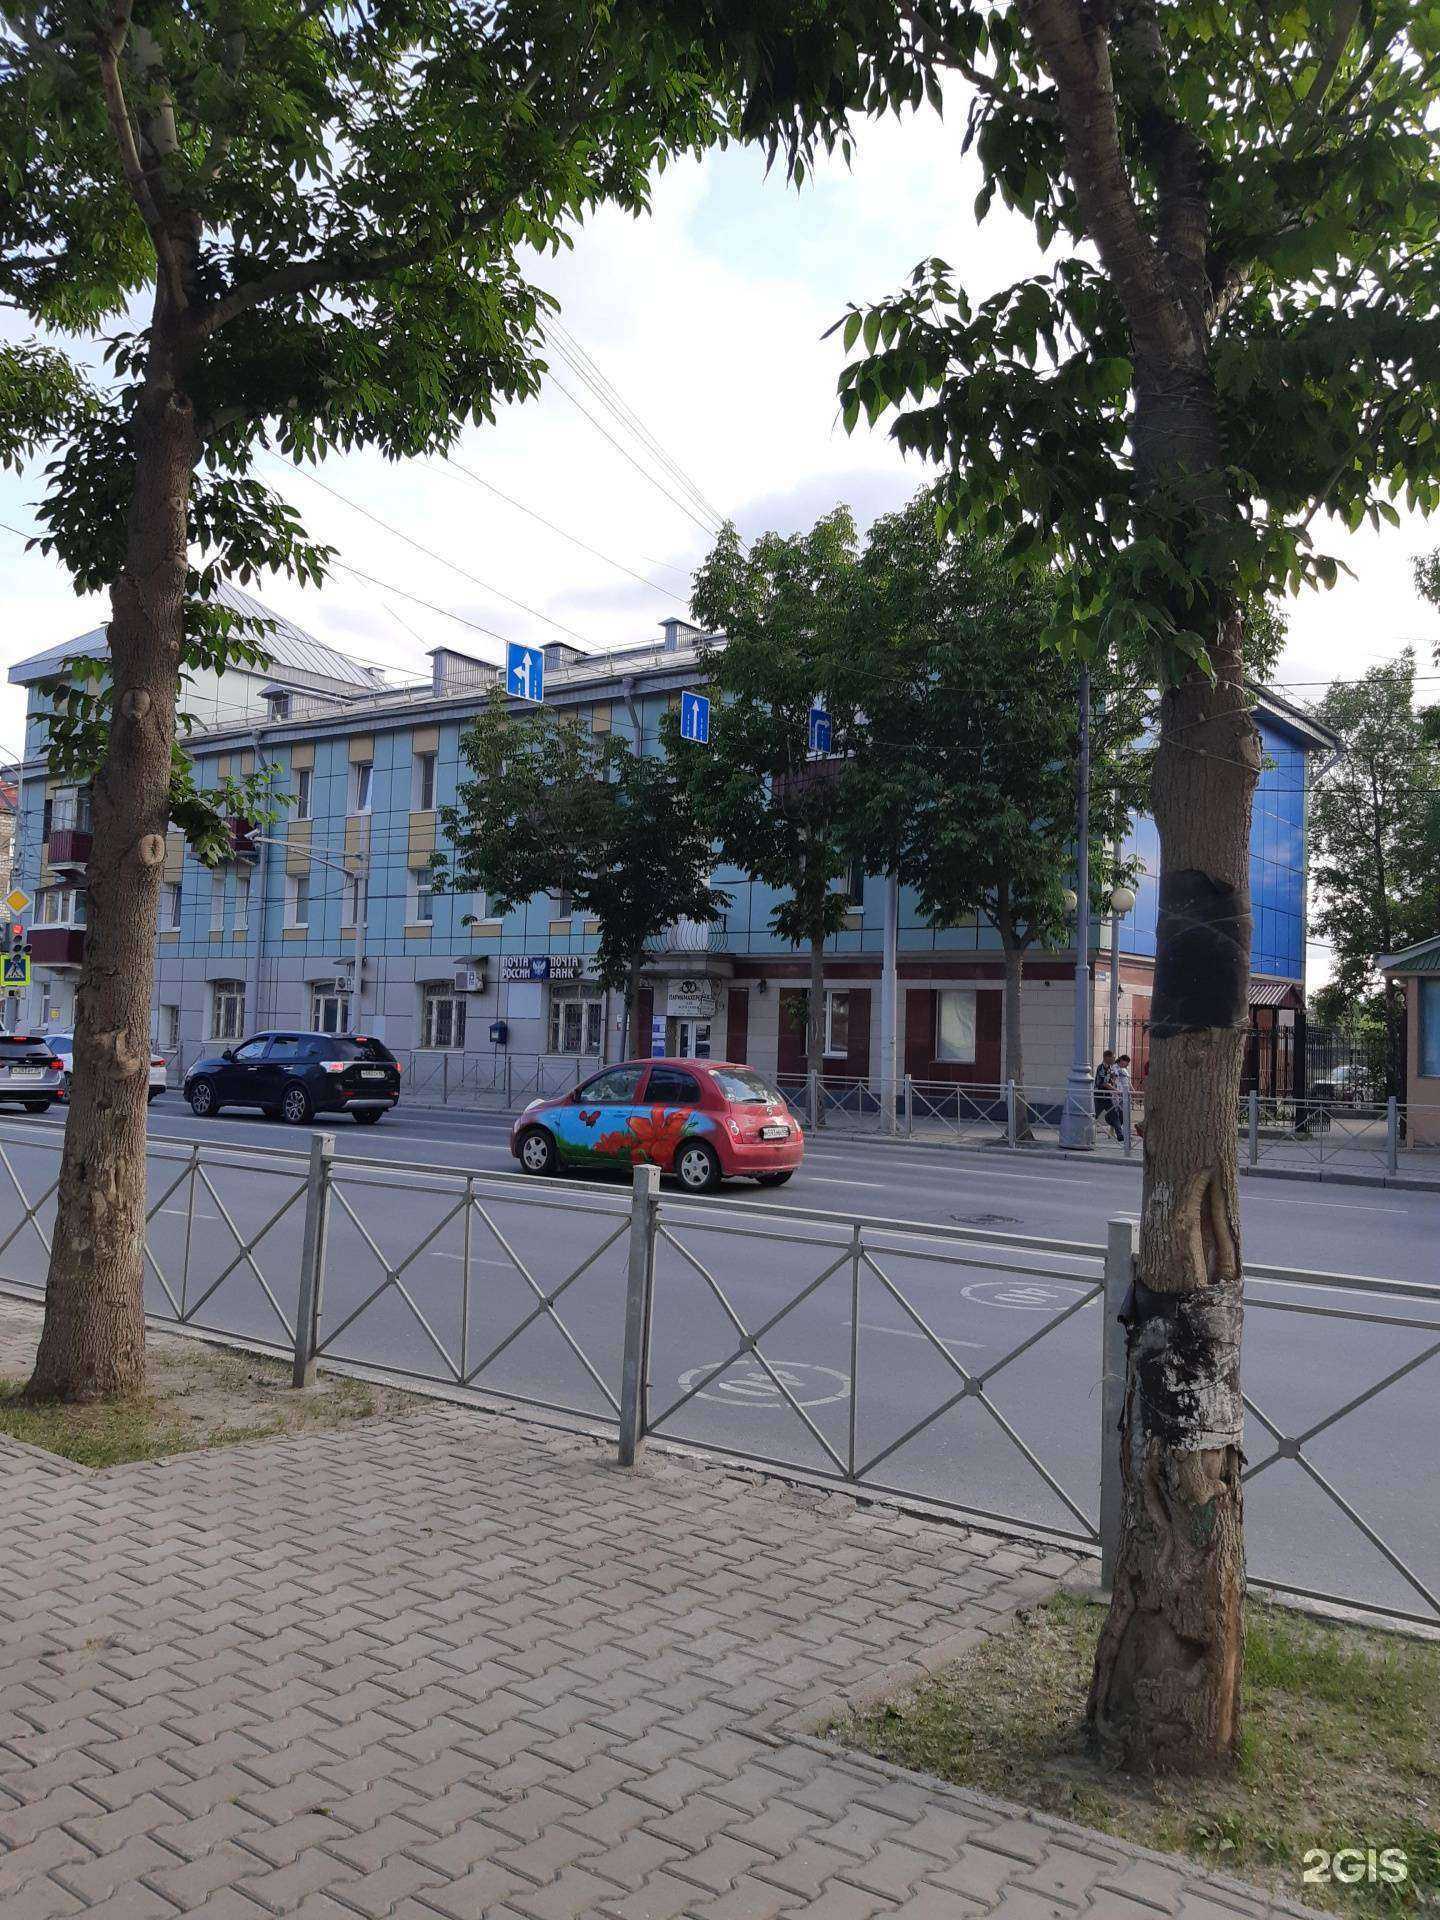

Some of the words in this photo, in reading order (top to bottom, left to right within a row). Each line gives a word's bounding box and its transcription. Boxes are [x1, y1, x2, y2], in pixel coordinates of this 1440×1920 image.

[502, 956, 529, 967] ПОЧТА
[550, 956, 578, 967] ПОЧТА
[502, 968, 531, 979] РОССИИ
[549, 968, 574, 979] БАНК
